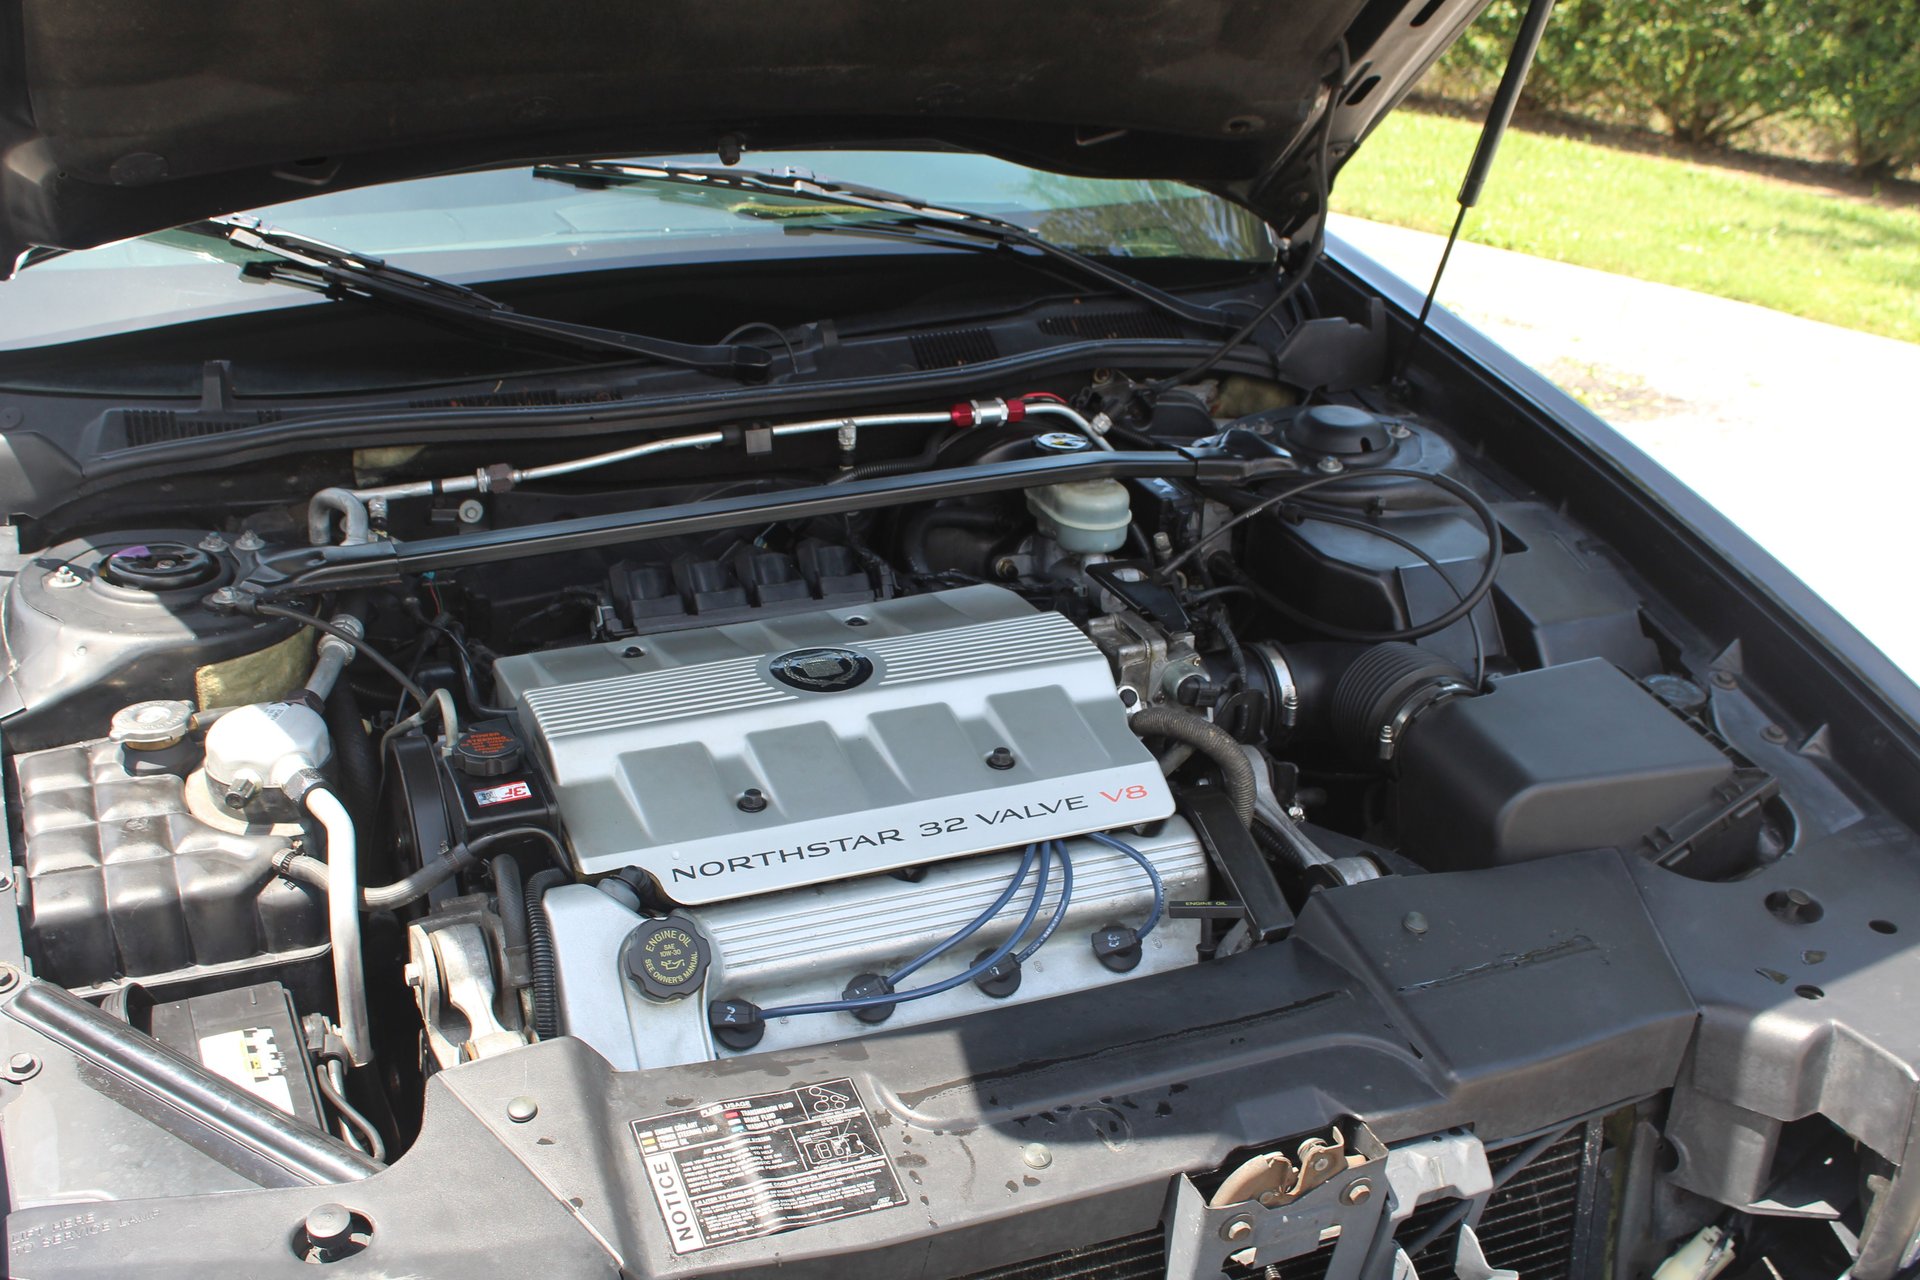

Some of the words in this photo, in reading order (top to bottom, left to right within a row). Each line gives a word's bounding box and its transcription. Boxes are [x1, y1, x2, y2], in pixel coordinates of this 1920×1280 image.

[671, 829, 905, 882] NORTHSTAR
[919, 817, 968, 837] 32
[975, 795, 1088, 824] VALVE
[1100, 784, 1148, 802] V8
[645, 930, 678, 952] ENGINE
[678, 933, 692, 948] OIL
[659, 949, 682, 957] 10W-30
[644, 958, 656, 973] SEE
[653, 971, 684, 984] OWNER'S
[682, 951, 698, 979] MANUAL
[724, 1100, 751, 1110] USAGE
[653, 1161, 694, 1242] NOTICE
[11, 1223, 44, 1245] LIFT
[52, 1212, 95, 1233] HERE
[11, 1242, 34, 1256] TO
[41, 1220, 112, 1248] SERVICE
